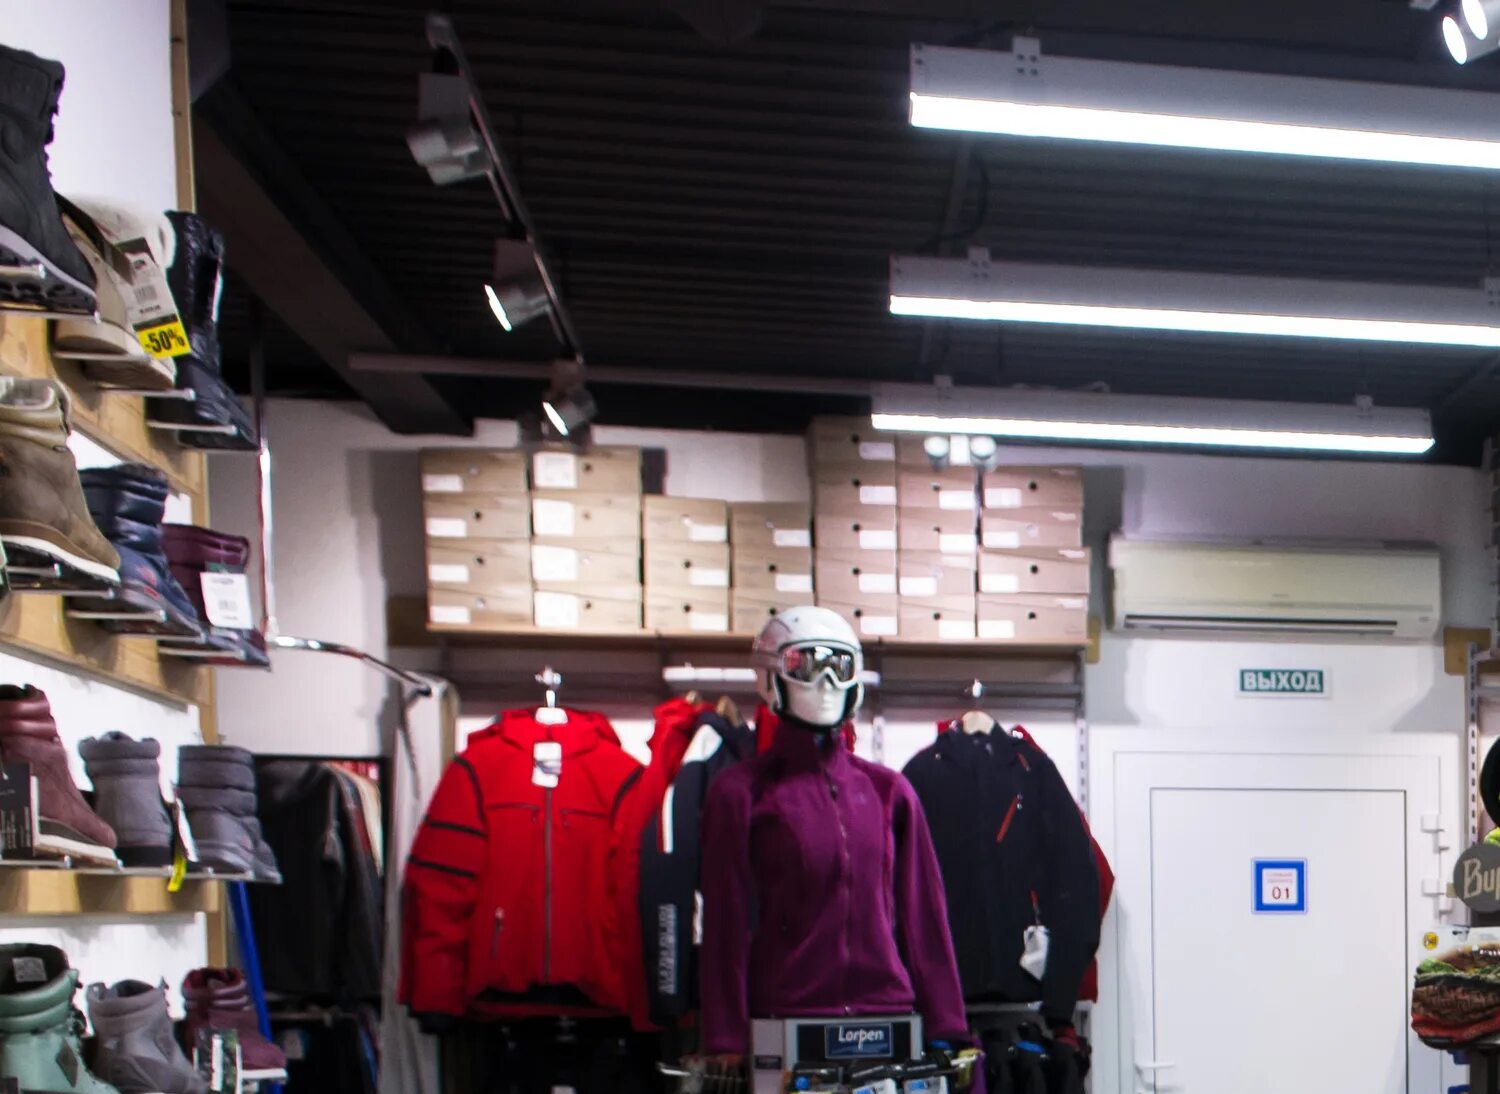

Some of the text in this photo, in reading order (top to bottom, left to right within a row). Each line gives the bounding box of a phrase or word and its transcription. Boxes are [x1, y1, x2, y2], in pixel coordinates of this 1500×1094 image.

[144, 329, 186, 354] -50%
[1243, 671, 1321, 691] ВЫХОД
[1271, 885, 1291, 900] 01
[838, 1026, 884, 1050] Lorpen
